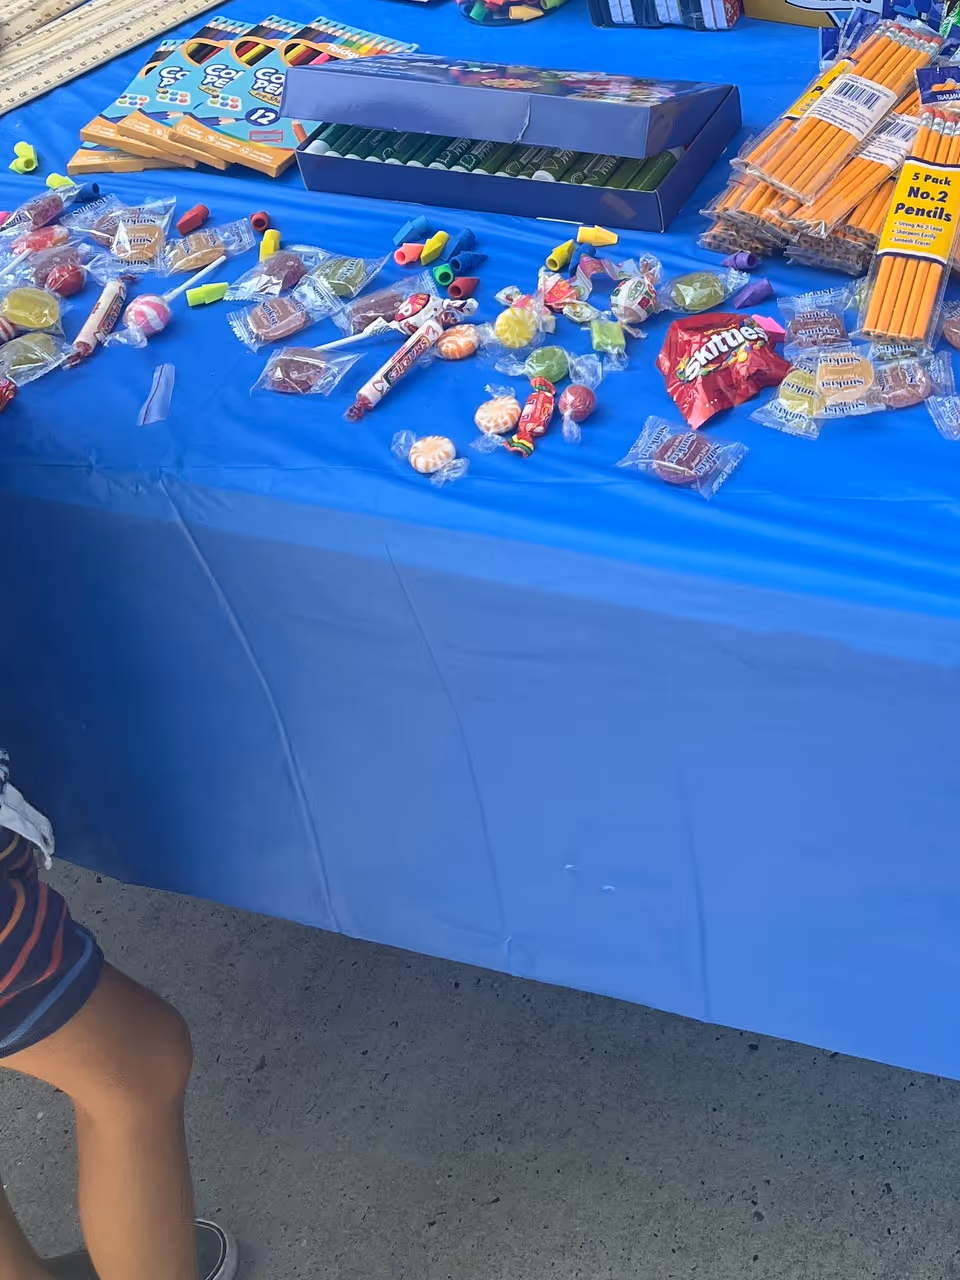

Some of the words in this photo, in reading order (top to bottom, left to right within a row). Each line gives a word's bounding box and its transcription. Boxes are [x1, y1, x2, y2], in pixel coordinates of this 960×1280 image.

[250, 109, 275, 124] 12
[924, 174, 952, 186] Pack
[907, 186, 948, 203] No.2
[894, 202, 952, 222] Pencils
[263, 302, 278, 326] Sunkist
[797, 326, 840, 337] Sunkist
[388, 338, 428, 379] SMARTIES
[685, 326, 768, 380] Skittles
[819, 356, 861, 365] Sunkist
[820, 378, 864, 389] Sunkist
[824, 401, 866, 414] Sunkist
[642, 424, 669, 458] Sunkist
[669, 432, 696, 464] Sunkist
[696, 442, 721, 475] Sunkist
